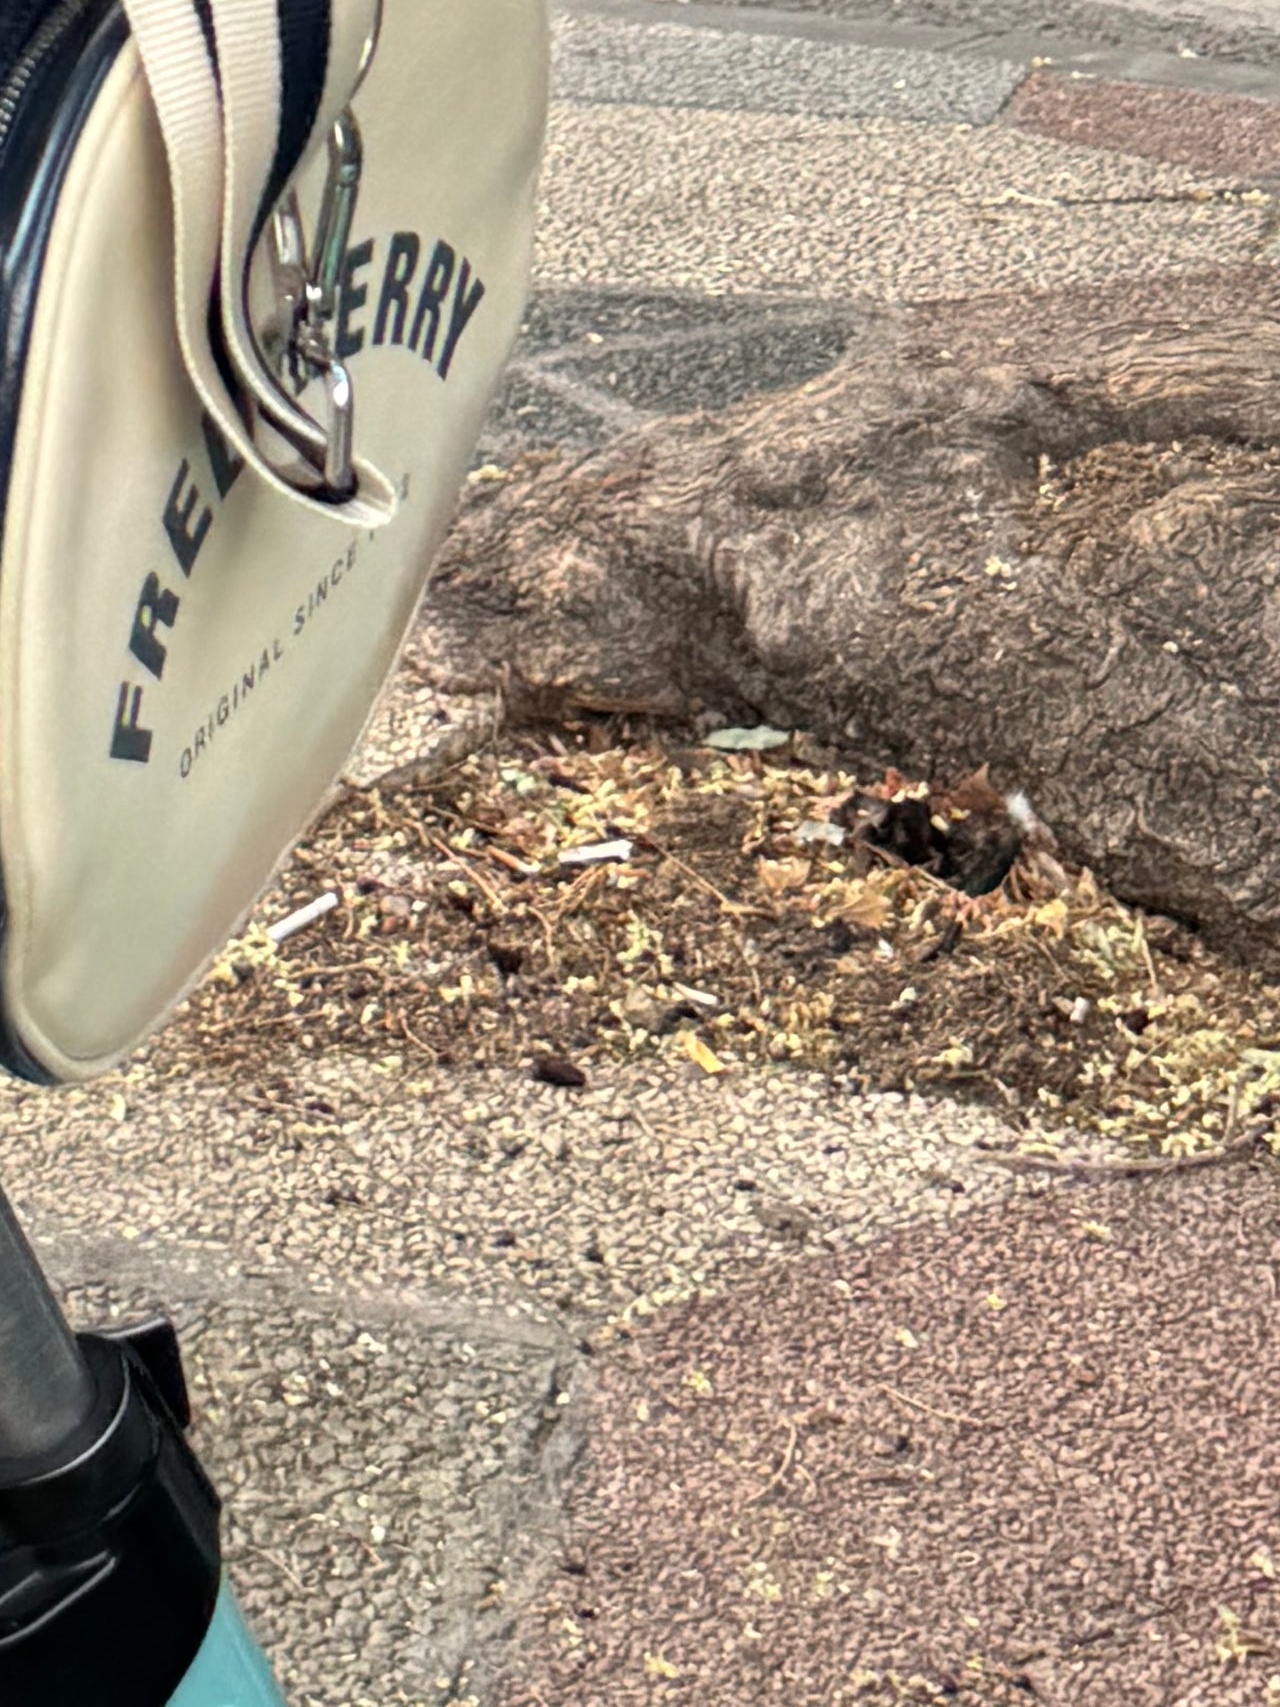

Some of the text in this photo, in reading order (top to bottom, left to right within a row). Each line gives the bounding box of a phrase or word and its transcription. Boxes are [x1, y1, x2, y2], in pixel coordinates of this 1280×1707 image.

[290, 230, 485, 395] ERRY
[180, 537, 358, 779] ORIGINAL SINCE
